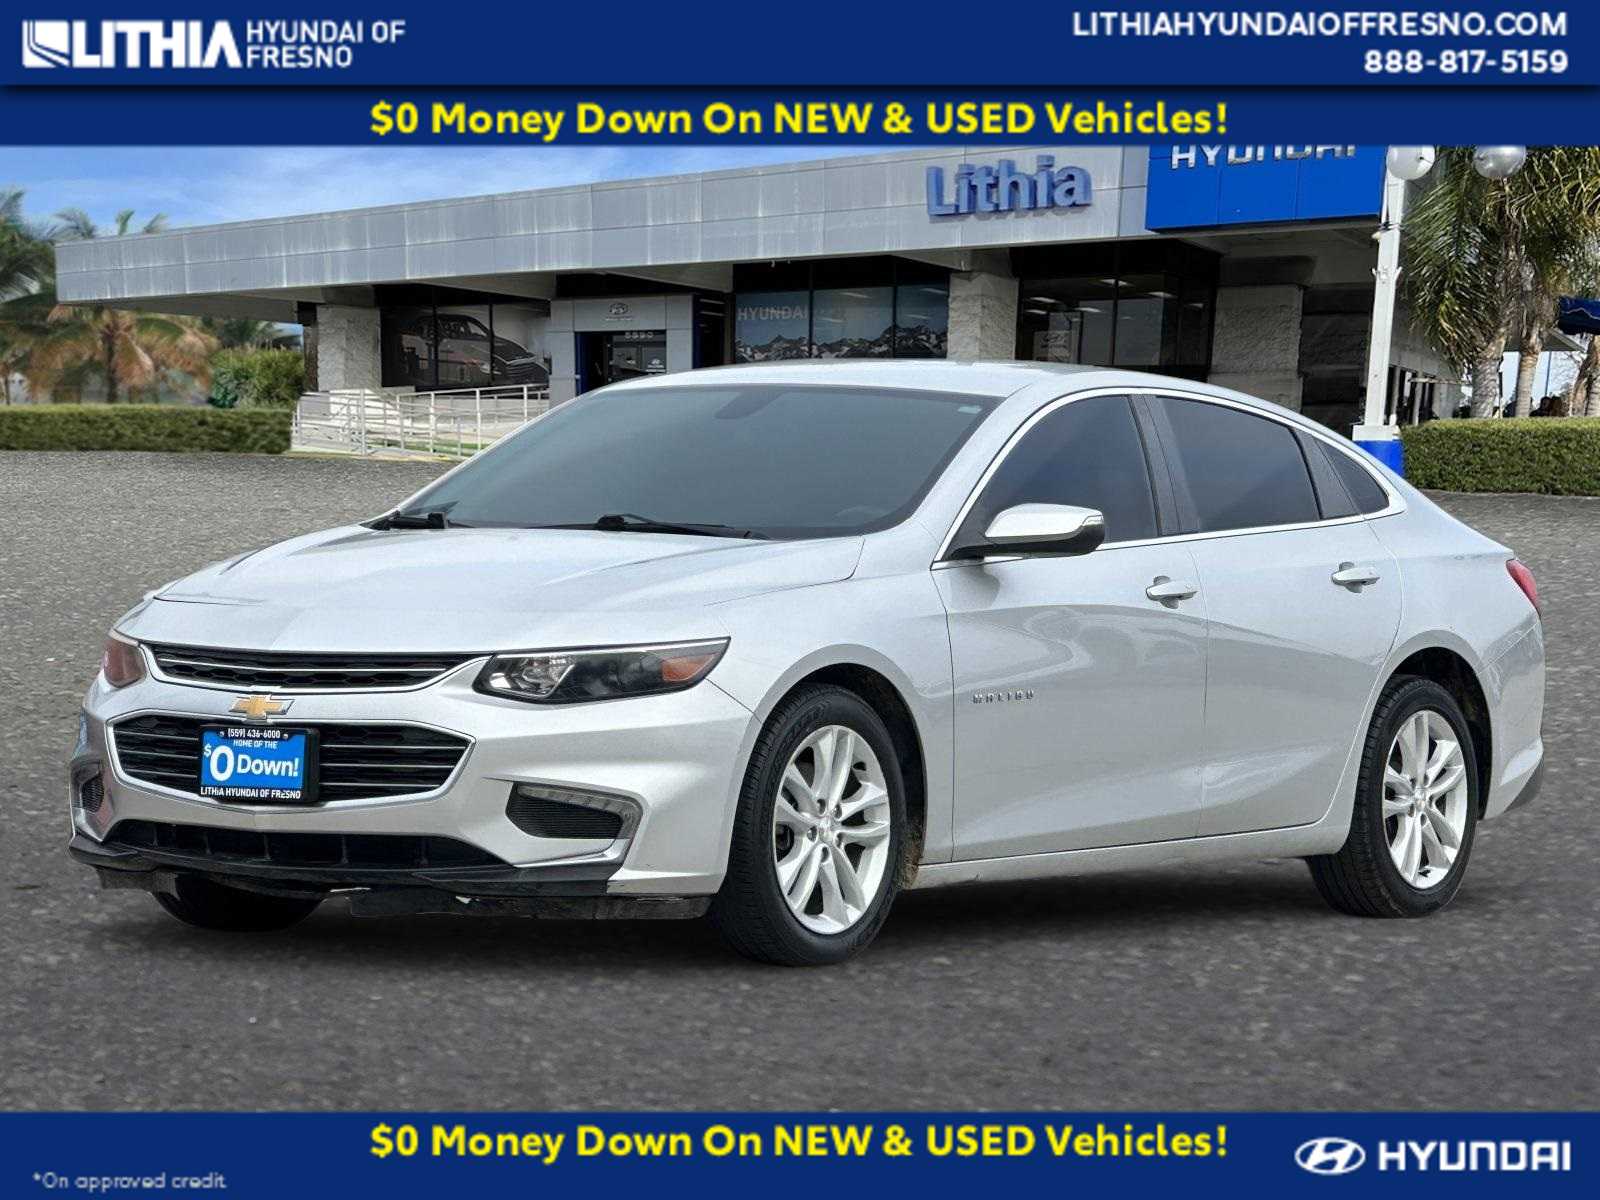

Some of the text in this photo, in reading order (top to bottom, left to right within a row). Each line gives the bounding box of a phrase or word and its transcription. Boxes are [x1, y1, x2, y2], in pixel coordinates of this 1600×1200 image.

[926, 155, 1092, 216] Lithia
[737, 305, 808, 321] HYUNDAI
[227, 728, 246, 738] (559)
[264, 741, 279, 749] THE
[236, 754, 300, 777] Down!
[225, 787, 258, 798] HYUNDAI
[259, 788, 270, 798] OF
[271, 789, 302, 799] FRESNO
